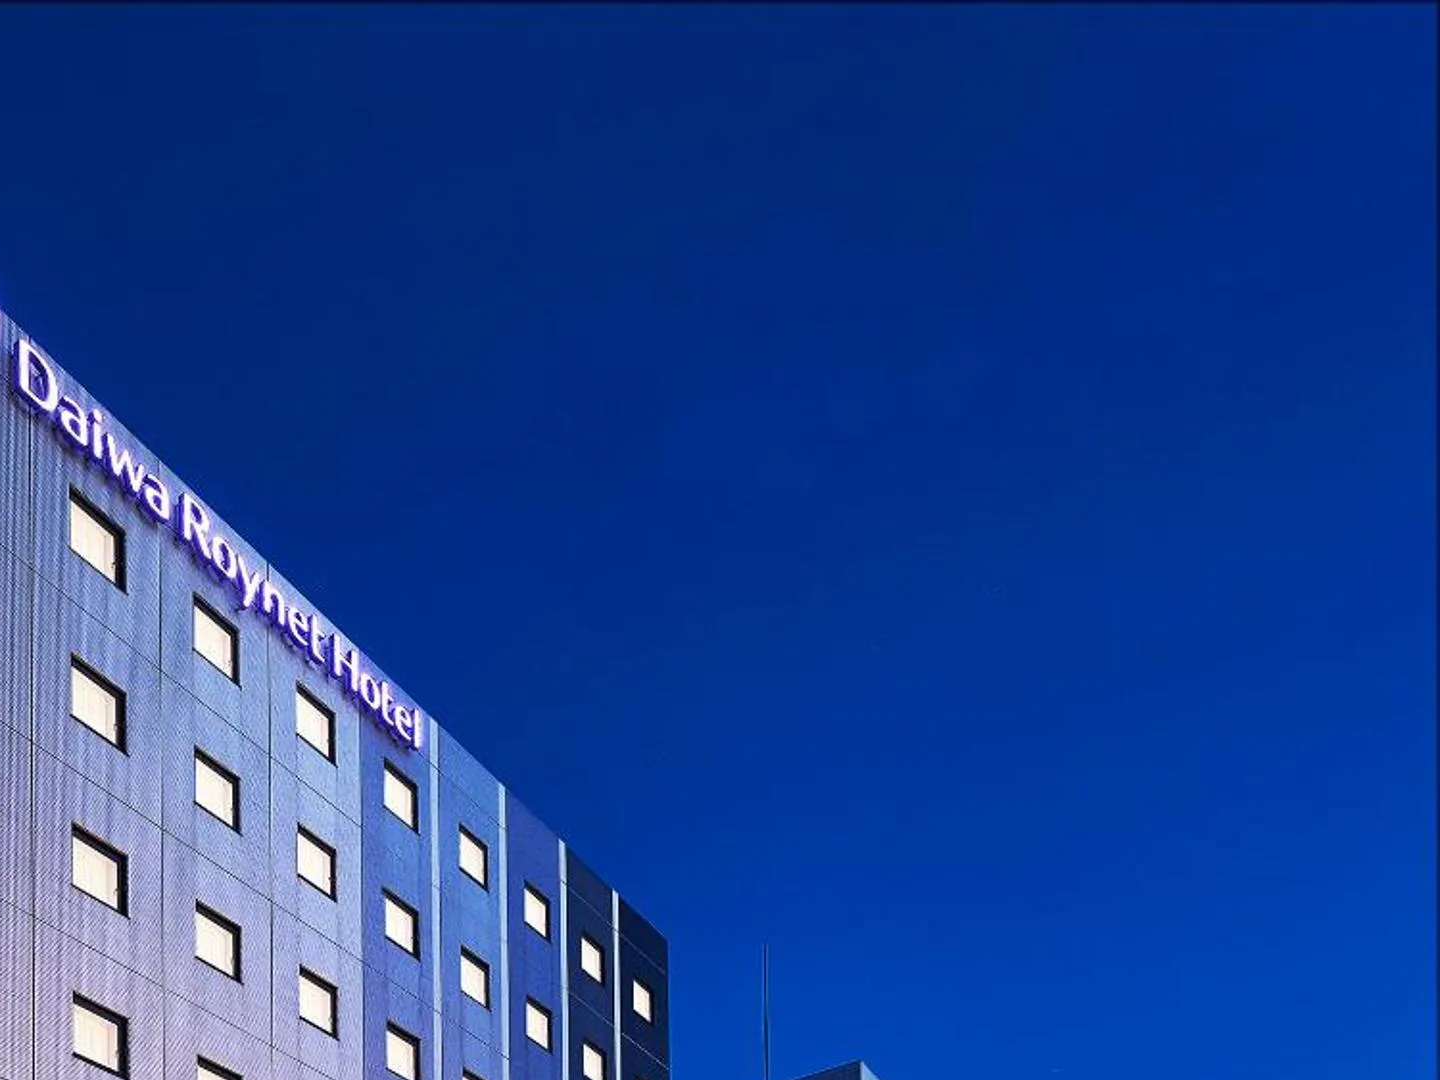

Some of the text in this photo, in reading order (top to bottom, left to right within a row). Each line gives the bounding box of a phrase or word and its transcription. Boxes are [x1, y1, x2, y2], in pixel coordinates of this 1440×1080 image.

[16, 337, 423, 751] Daiwa Roynet Hotel
